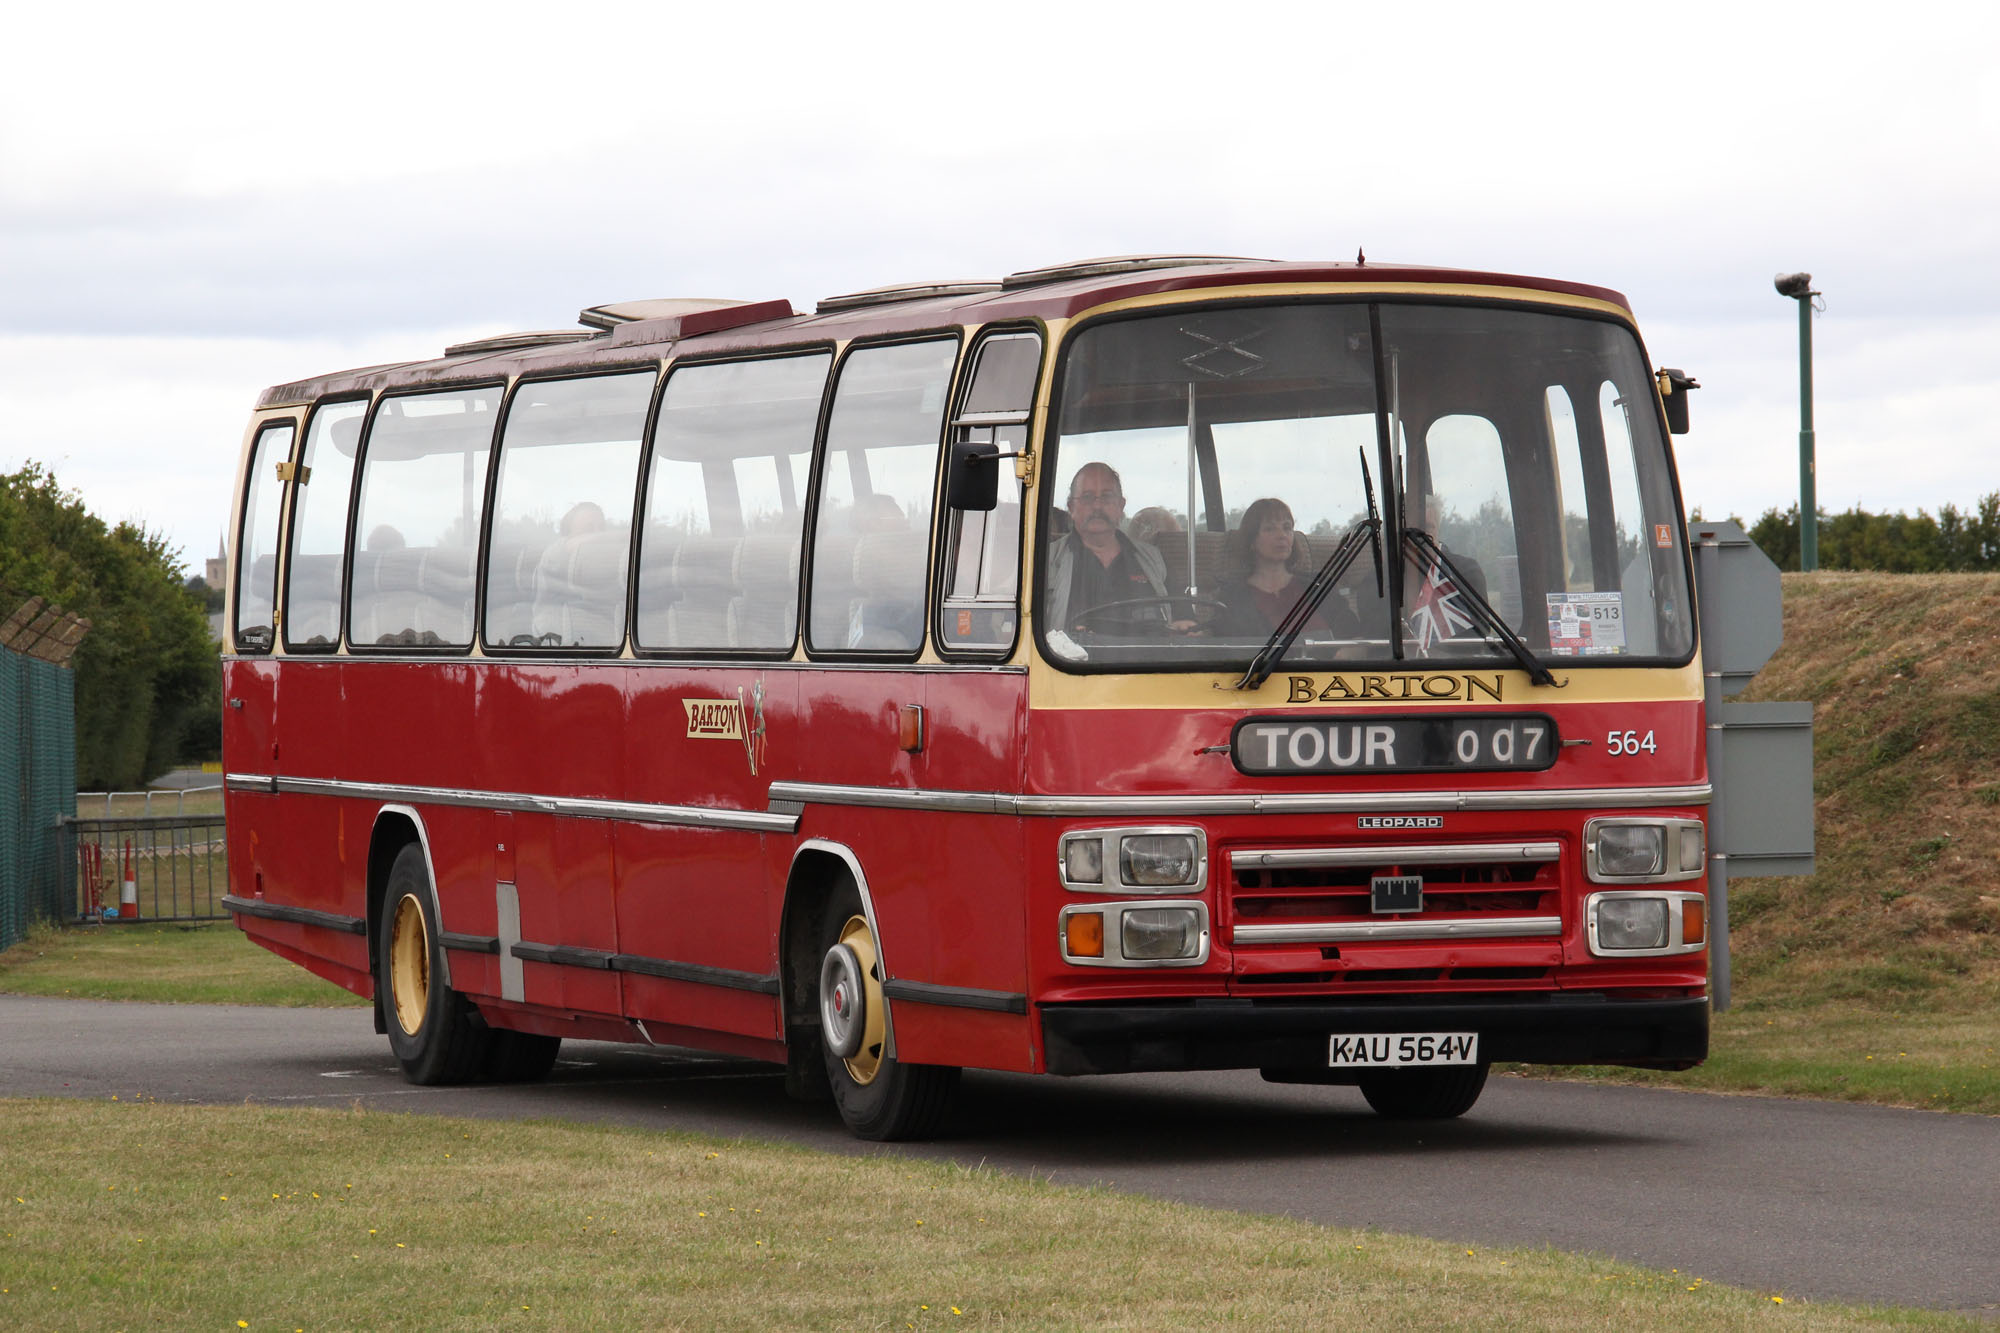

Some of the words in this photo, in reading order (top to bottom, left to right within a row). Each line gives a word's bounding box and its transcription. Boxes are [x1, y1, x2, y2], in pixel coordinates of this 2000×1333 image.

[1594, 607, 1620, 620] 513
[1286, 674, 1505, 704] BARTON
[689, 704, 738, 733] BARTON
[1256, 726, 1397, 768] TOUR
[1607, 729, 1657, 756] 564
[1362, 817, 1439, 828] LEOPARD
[1332, 1037, 1391, 1063] KAU
[1398, 1036, 1474, 1062] 564V
